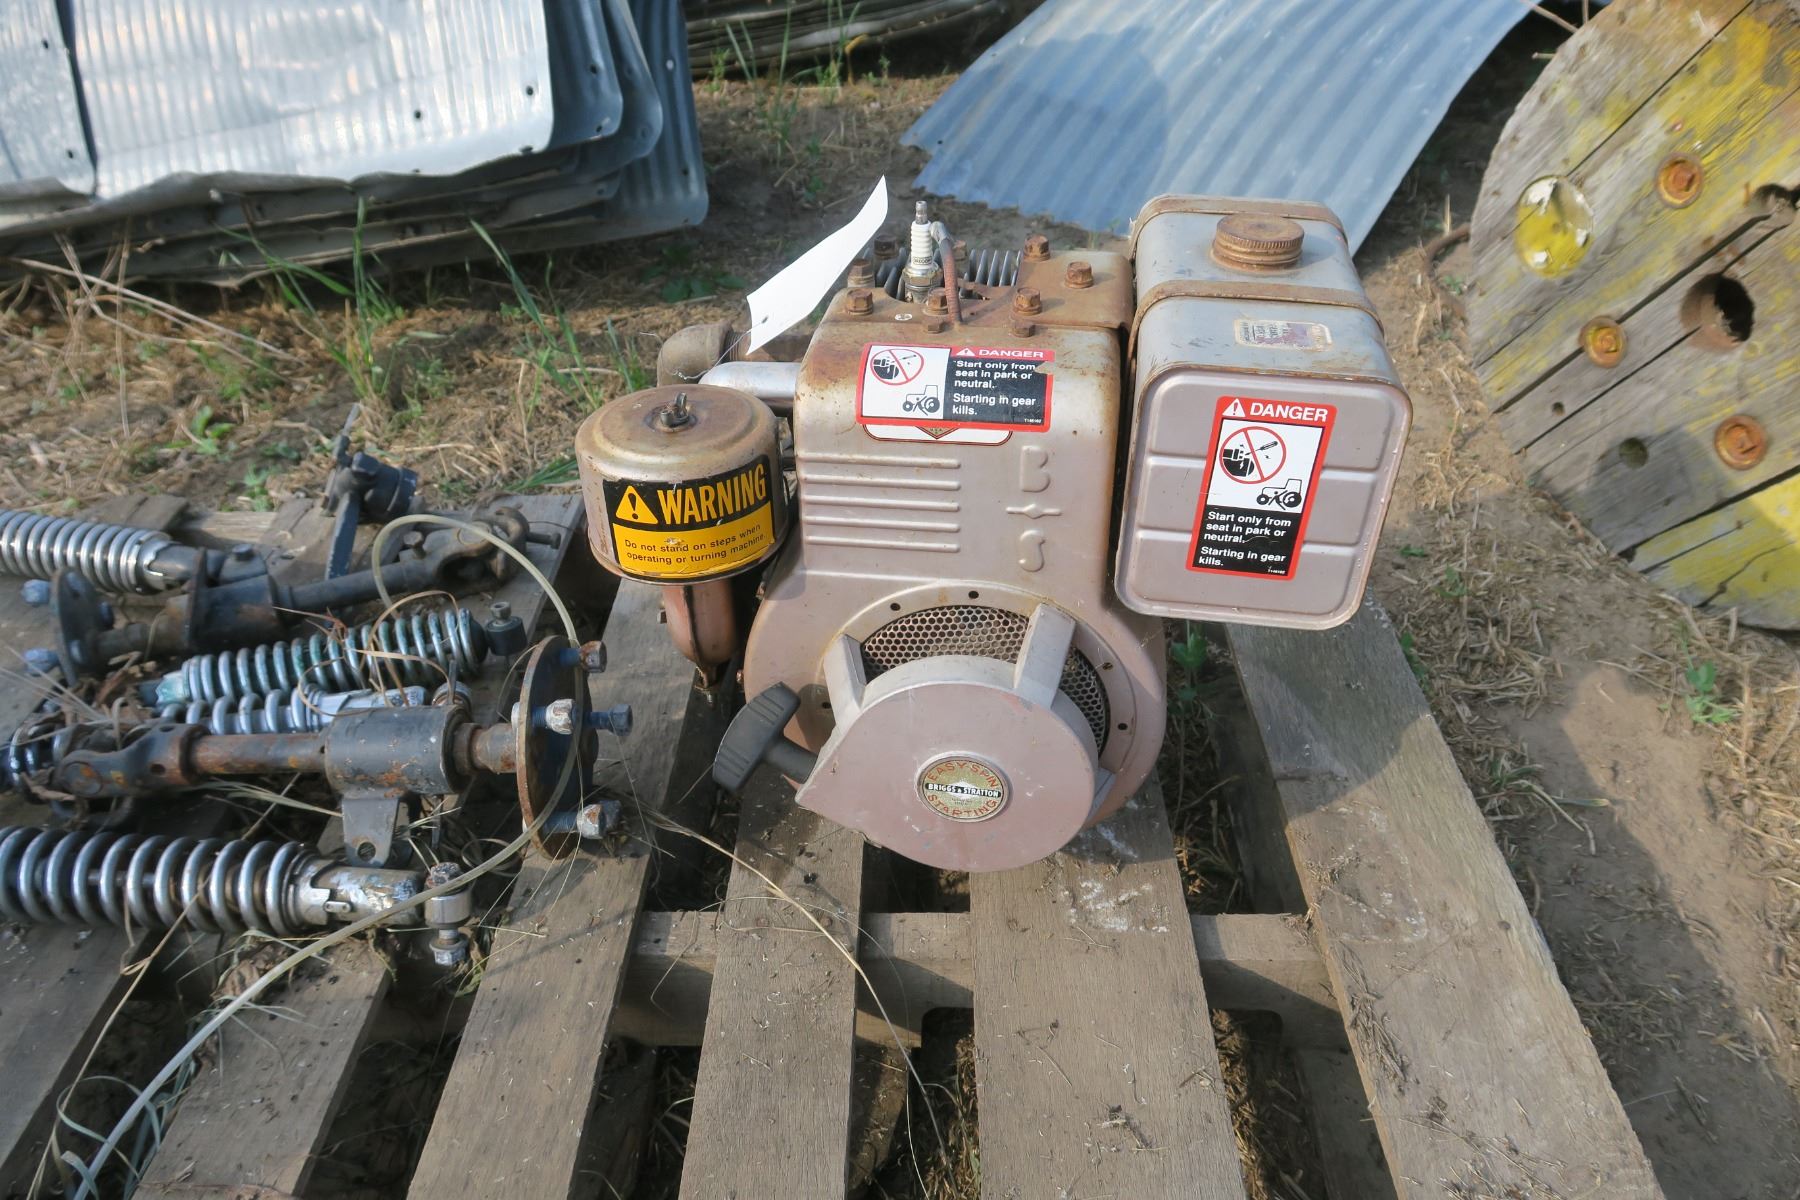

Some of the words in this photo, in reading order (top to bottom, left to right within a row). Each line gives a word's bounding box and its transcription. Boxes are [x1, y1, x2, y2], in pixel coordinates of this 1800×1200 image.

[978, 349, 1044, 358] DANGER
[956, 360, 982, 368] Start
[984, 362, 1008, 370] only
[1011, 362, 1036, 370] from
[993, 371, 1018, 380] park
[954, 380, 995, 389] neutral.
[953, 393, 996, 406] Starting
[998, 394, 1009, 404] in
[1011, 397, 1036, 407] gear
[952, 405, 978, 415] kills.
[1249, 402, 1329, 423] DANGER
[1020, 445, 1051, 493] B
[657, 463, 767, 525] WARNING
[1208, 511, 1235, 522] Start
[1237, 515, 1263, 526] only
[1265, 517, 1292, 527] from
[1206, 523, 1230, 532] seat
[1232, 524, 1243, 532] in
[1245, 527, 1271, 536] park
[1273, 529, 1287, 537] or
[624, 539, 638, 549] Do
[640, 543, 657, 552] not
[660, 543, 689, 553] stand
[693, 543, 707, 551] on
[710, 536, 737, 550] steps
[739, 524, 761, 539] when
[1203, 533, 1246, 544] neutral.
[626, 552, 672, 565] operating
[675, 556, 687, 564] or
[690, 549, 727, 562] turning
[730, 534, 767, 554] machine.
[1200, 546, 1245, 560] Starting
[1247, 551, 1258, 559] in
[1260, 553, 1287, 562] gear
[1198, 556, 1224, 566] kills.
[928, 783, 956, 792] BRIGGS
[963, 786, 999, 797] STRATTON
[928, 794, 998, 817] STARTING
